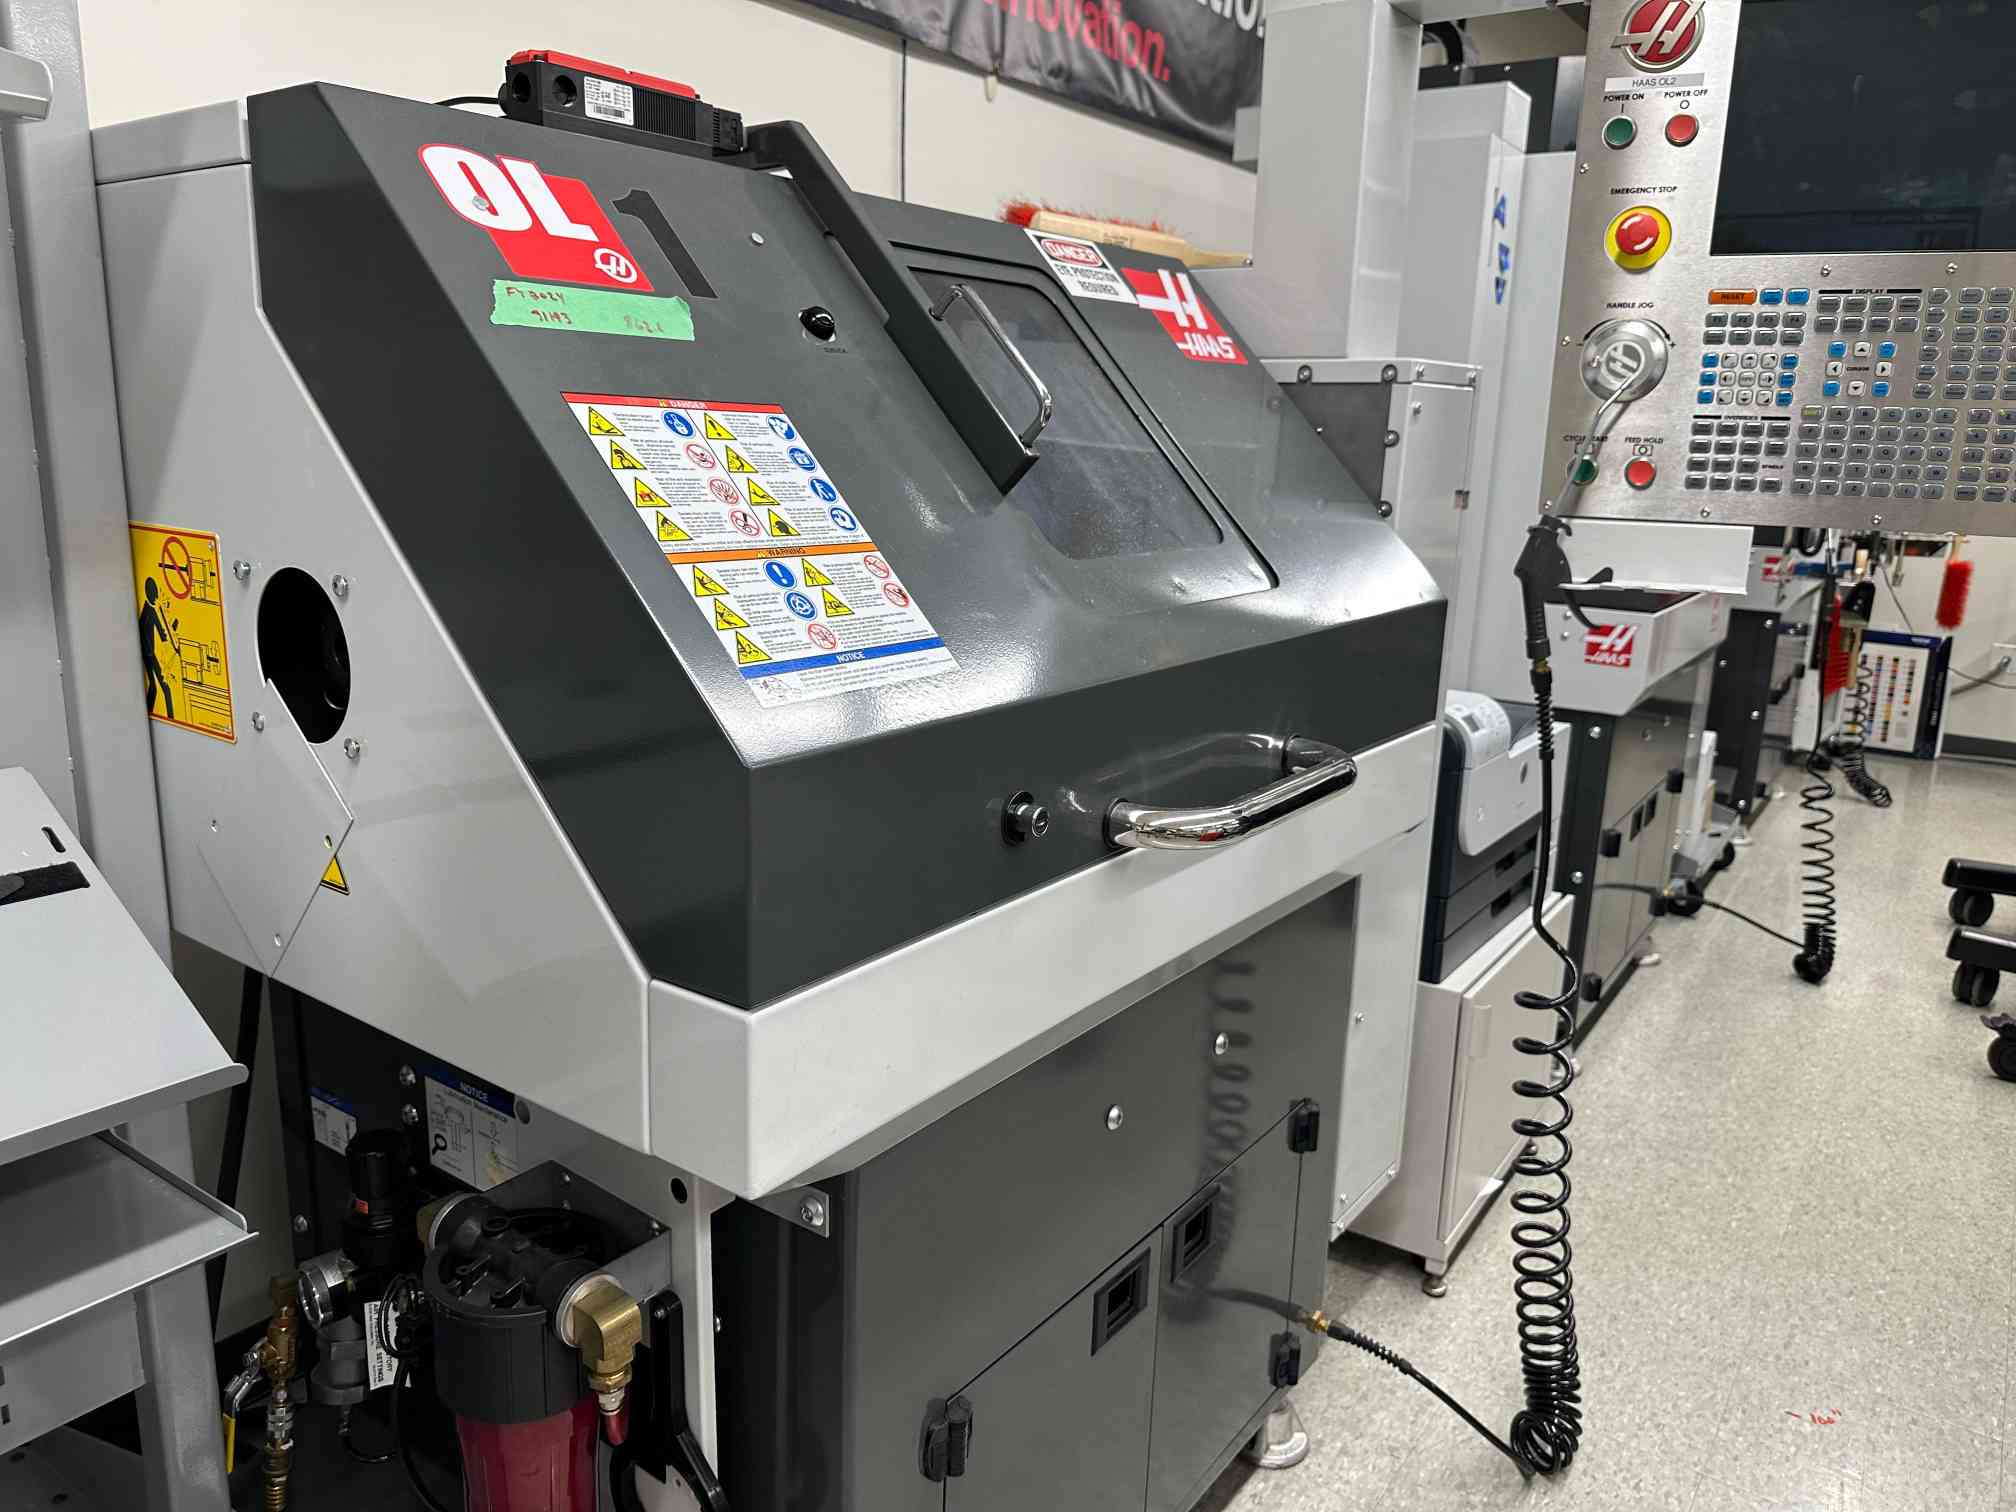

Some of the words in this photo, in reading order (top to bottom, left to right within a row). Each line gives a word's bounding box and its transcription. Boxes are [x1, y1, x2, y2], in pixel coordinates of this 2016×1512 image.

[1632, 78, 1657, 87] HAAS
[1603, 94, 1629, 102] POWER
[1631, 93, 1644, 101] ON
[1664, 90, 1691, 98] POWER
[1693, 88, 1708, 97] OFF
[1611, 187, 1656, 195] EMERGENCY
[837, 650, 865, 663] NOTICE
[460, 1080, 488, 1101] NOTICE
